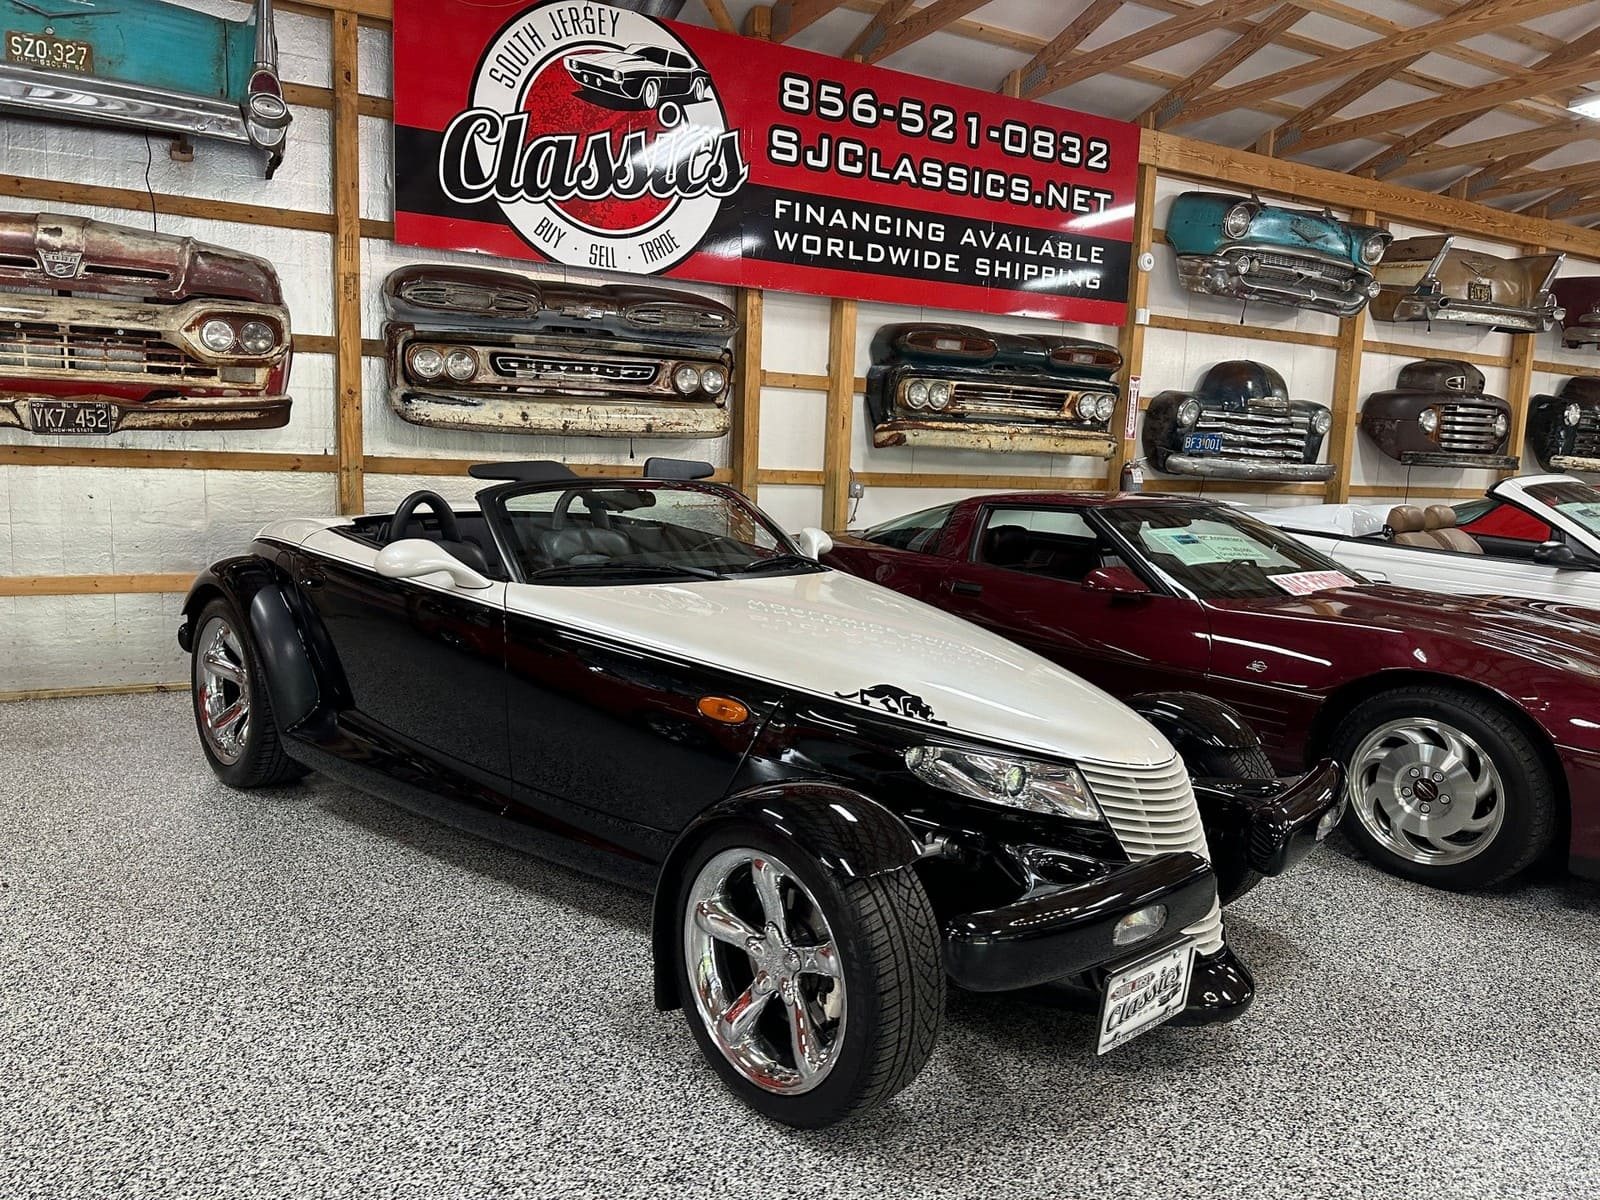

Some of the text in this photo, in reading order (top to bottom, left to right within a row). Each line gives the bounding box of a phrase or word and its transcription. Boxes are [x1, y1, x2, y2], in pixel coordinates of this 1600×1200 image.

[489, 6, 620, 89] SOUTH JERSEY
[439, 101, 749, 204] Classics
[782, 77, 1108, 169] 856-521-0832
[533, 216, 681, 268] BUY SELL TRADE
[774, 199, 1105, 264] FINANCING AVAILABLE
[774, 230, 1101, 290] WORLDWIDE SHIPPING
[33, 408, 108, 428] YK7 452
[1104, 960, 1184, 1035] Classics
